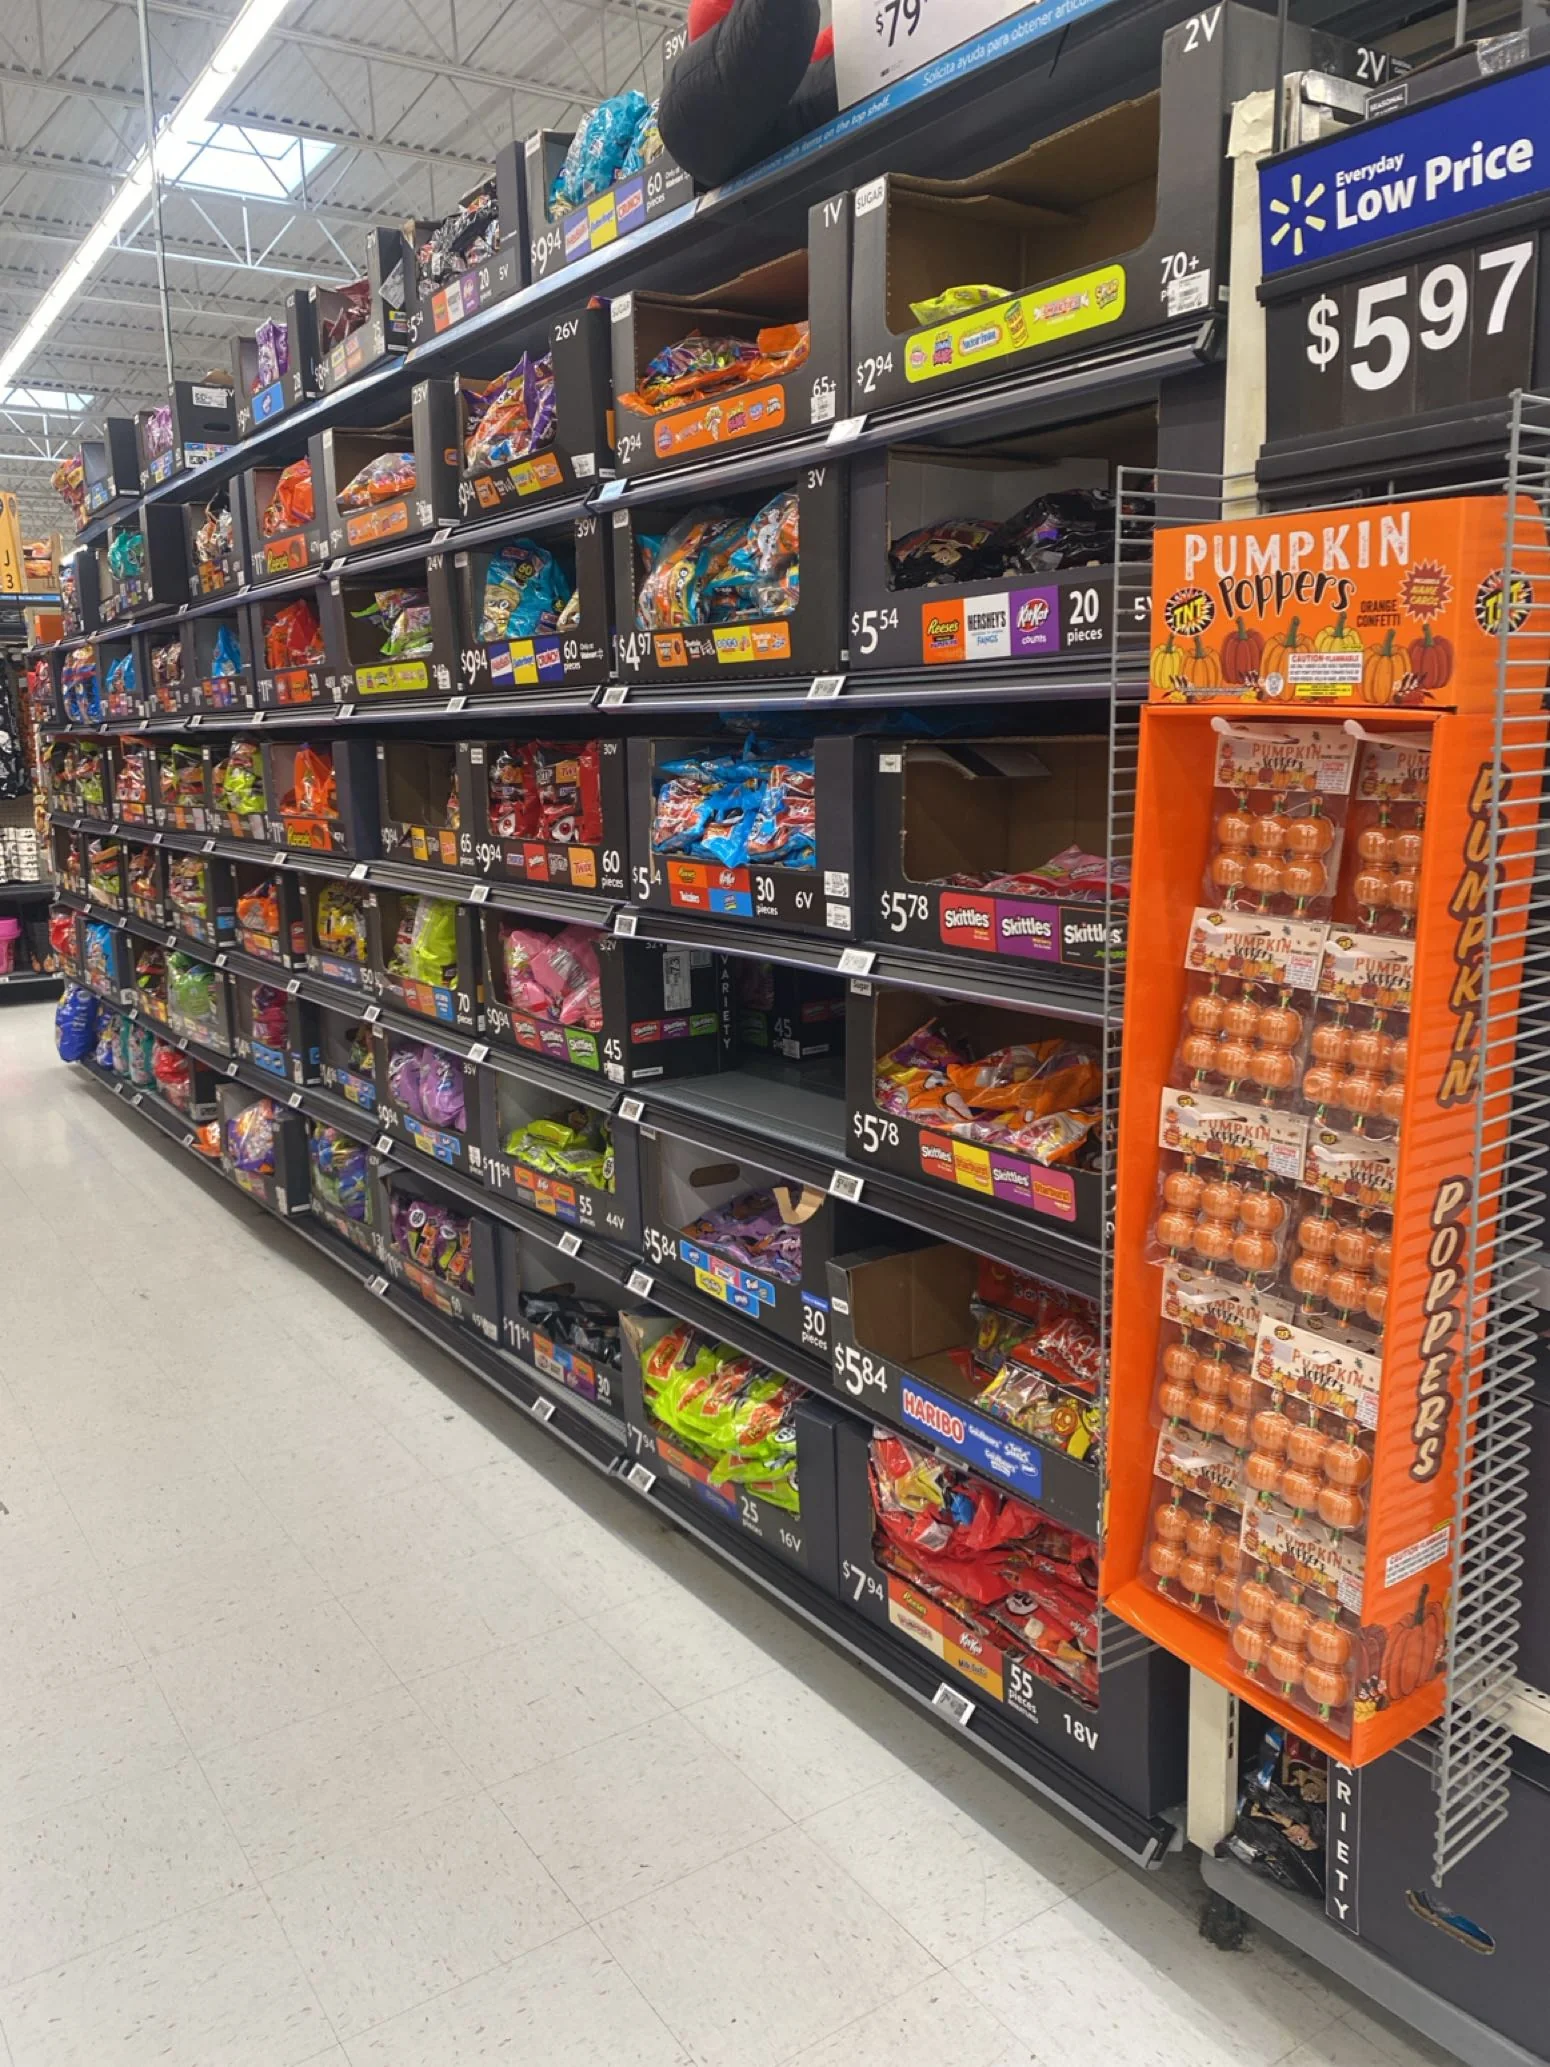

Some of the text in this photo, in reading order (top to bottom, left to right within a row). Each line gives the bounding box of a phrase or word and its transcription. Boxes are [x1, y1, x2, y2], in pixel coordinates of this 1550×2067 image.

[1183, 7, 1220, 53] 2V
[665, 30, 688, 60] 39V
[921, 11, 1053, 87] Solicita ayuda para obtener
[1357, 47, 1386, 82] 2V
[851, 110, 867, 126] top
[1335, 153, 1405, 188] Everyday
[647, 171, 663, 196] 60
[1336, 138, 1534, 230] Low Price
[855, 185, 884, 211] SUGAR
[823, 198, 844, 229] 1V
[1160, 251, 1199, 284] 70+
[554, 319, 579, 342] 26V
[807, 467, 827, 489] 3V
[1184, 511, 1411, 581] PUMPKIN
[1218, 568, 1356, 619] Poppers
[1069, 588, 1100, 625] 20
[1172, 599, 1206, 630] TNT
[1360, 599, 1398, 614] ORANGE
[967, 611, 1007, 632] HERSHEY'S
[1356, 614, 1401, 628] CONFETTI
[1066, 627, 1103, 646] pieces
[564, 640, 577, 660] 60
[1251, 742, 1321, 760] PUMPKIN
[603, 850, 620, 873] 60
[601, 876, 624, 889] pieces
[755, 876, 776, 902] 30
[756, 903, 779, 917] pieces
[795, 891, 814, 910] 6V
[945, 906, 990, 929] Skittles
[1001, 915, 1052, 937] Skittles
[1223, 931, 1292, 954] PUMPKIN
[1355, 957, 1414, 979] PUMPK
[457, 992, 470, 1013] 70
[721, 955, 731, 1049] VARIETY
[774, 1017, 793, 1038] 45
[604, 1038, 623, 1061] 45
[921, 1145, 952, 1163] Skittles
[993, 1168, 1030, 1187] Skittles
[579, 1195, 593, 1216] 55
[606, 1212, 625, 1230] 44V
[803, 1306, 826, 1336] 30
[1411, 1180, 1466, 1477] POPPERS
[902, 1389, 965, 1445] HARIBO
[741, 1496, 759, 1523] 25
[779, 1528, 801, 1552] 16V
[1010, 1664, 1033, 1699] 55
[1063, 1714, 1099, 1750] 18V
